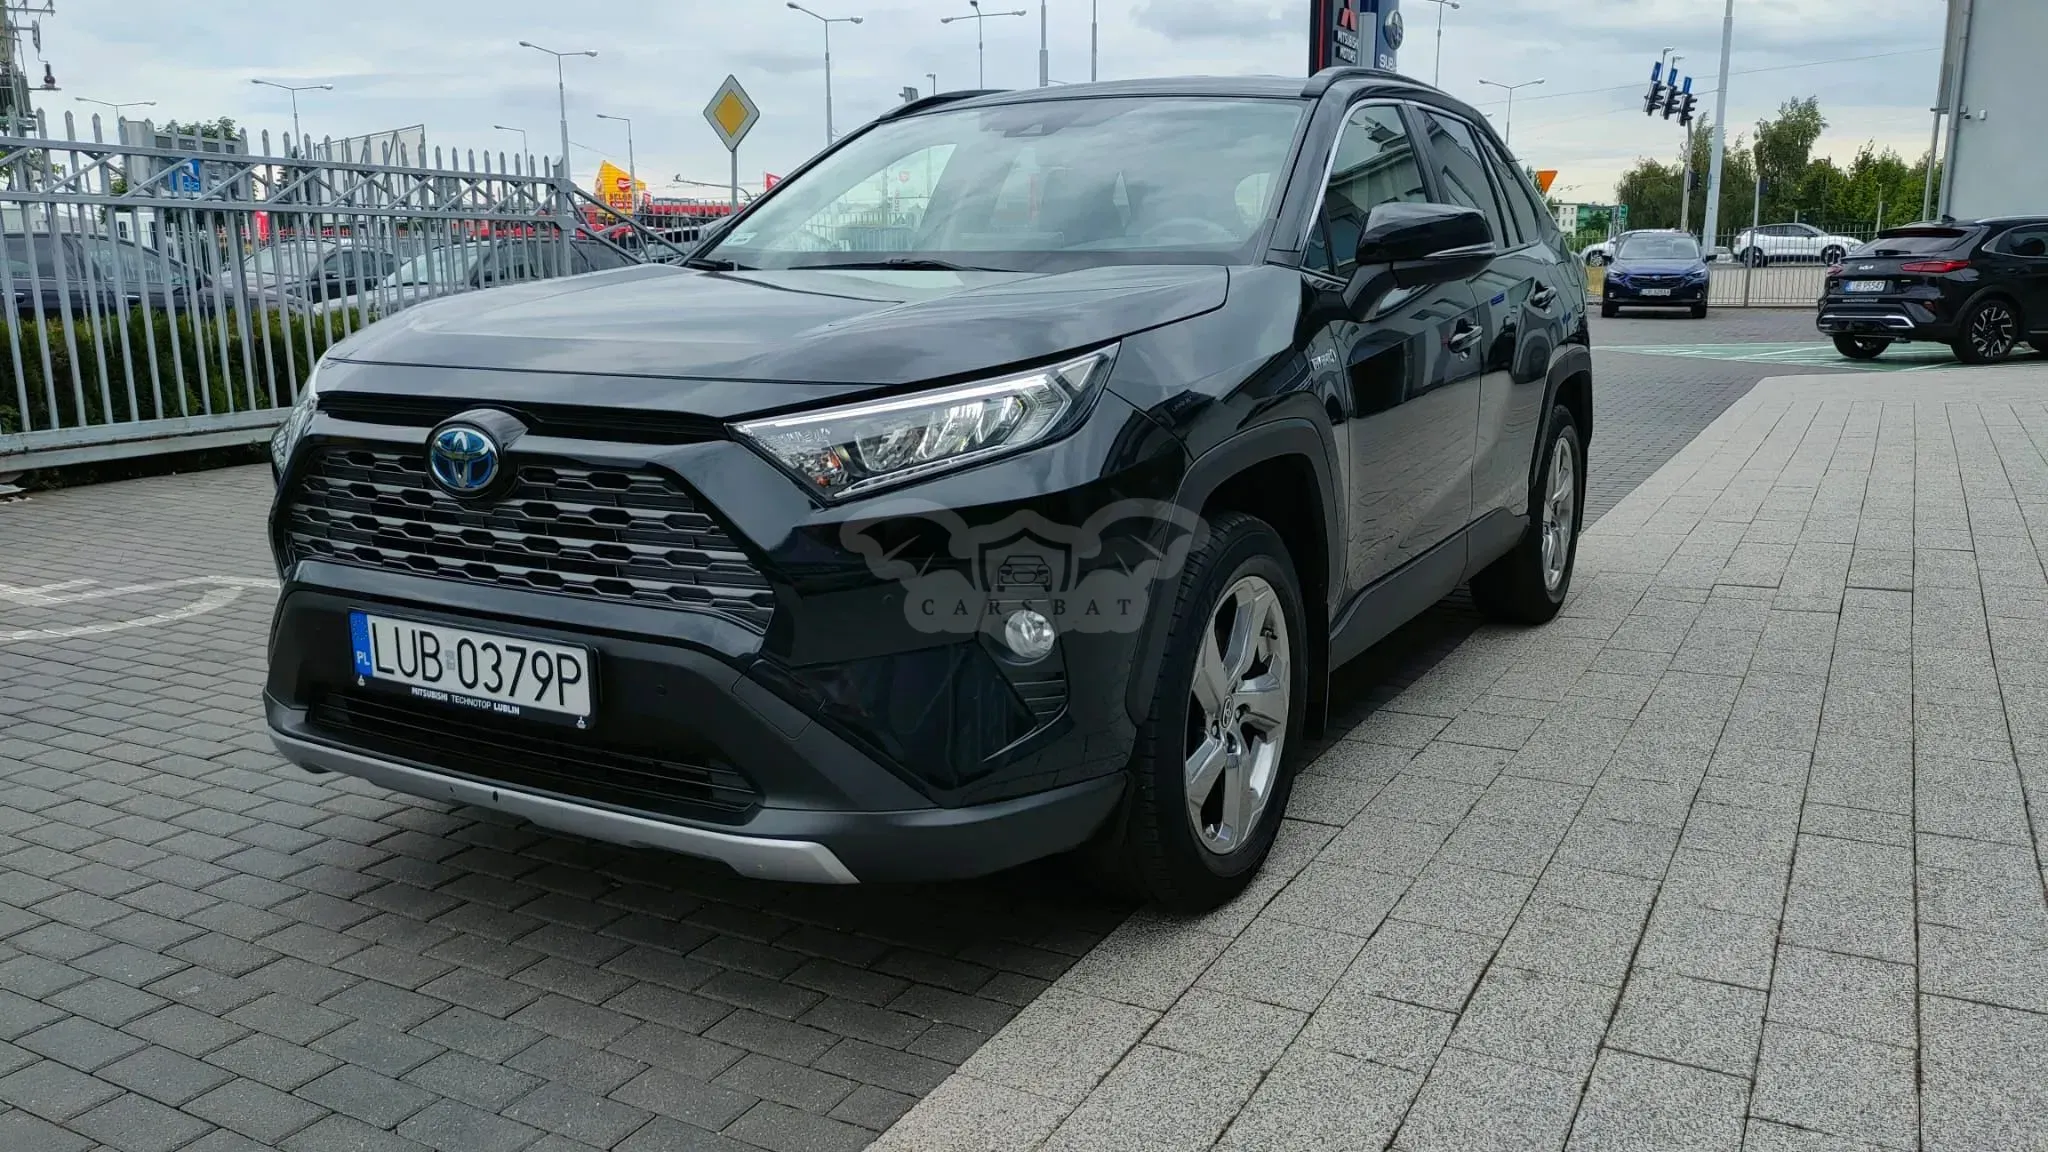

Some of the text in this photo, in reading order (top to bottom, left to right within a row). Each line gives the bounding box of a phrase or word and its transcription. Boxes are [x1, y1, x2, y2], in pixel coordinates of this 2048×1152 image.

[356, 651, 370, 666] PL
[371, 622, 582, 707] LUB 0379P
[411, 686, 520, 716] MITSUBISHI TECHNOTOP LUBLIN
